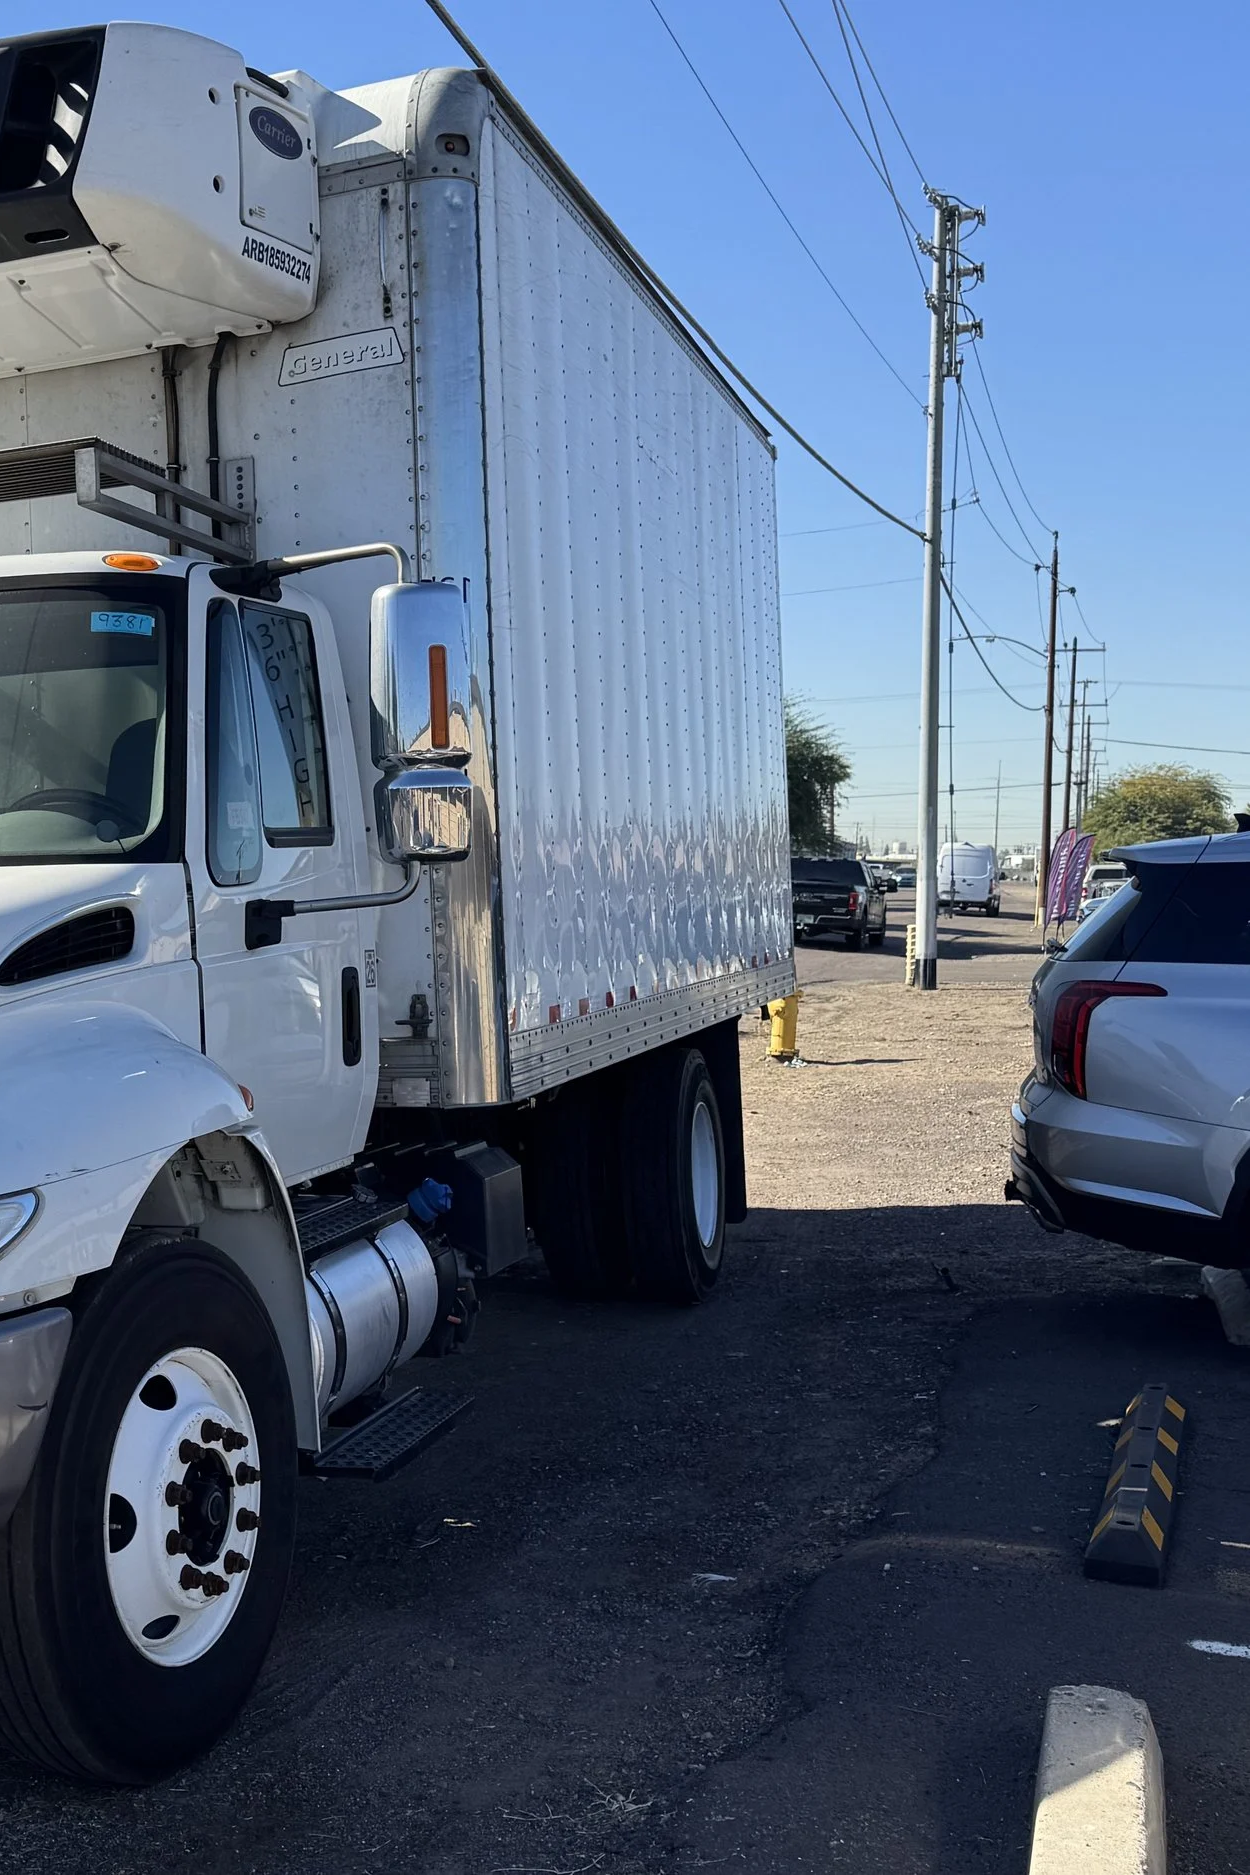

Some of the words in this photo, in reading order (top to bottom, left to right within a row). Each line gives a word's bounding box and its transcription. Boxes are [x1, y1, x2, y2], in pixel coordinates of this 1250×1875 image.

[257, 115, 296, 148] Carrier
[242, 236, 311, 284] ARB185932274
[293, 337, 393, 375] General
[98, 613, 145, 629] 9381
